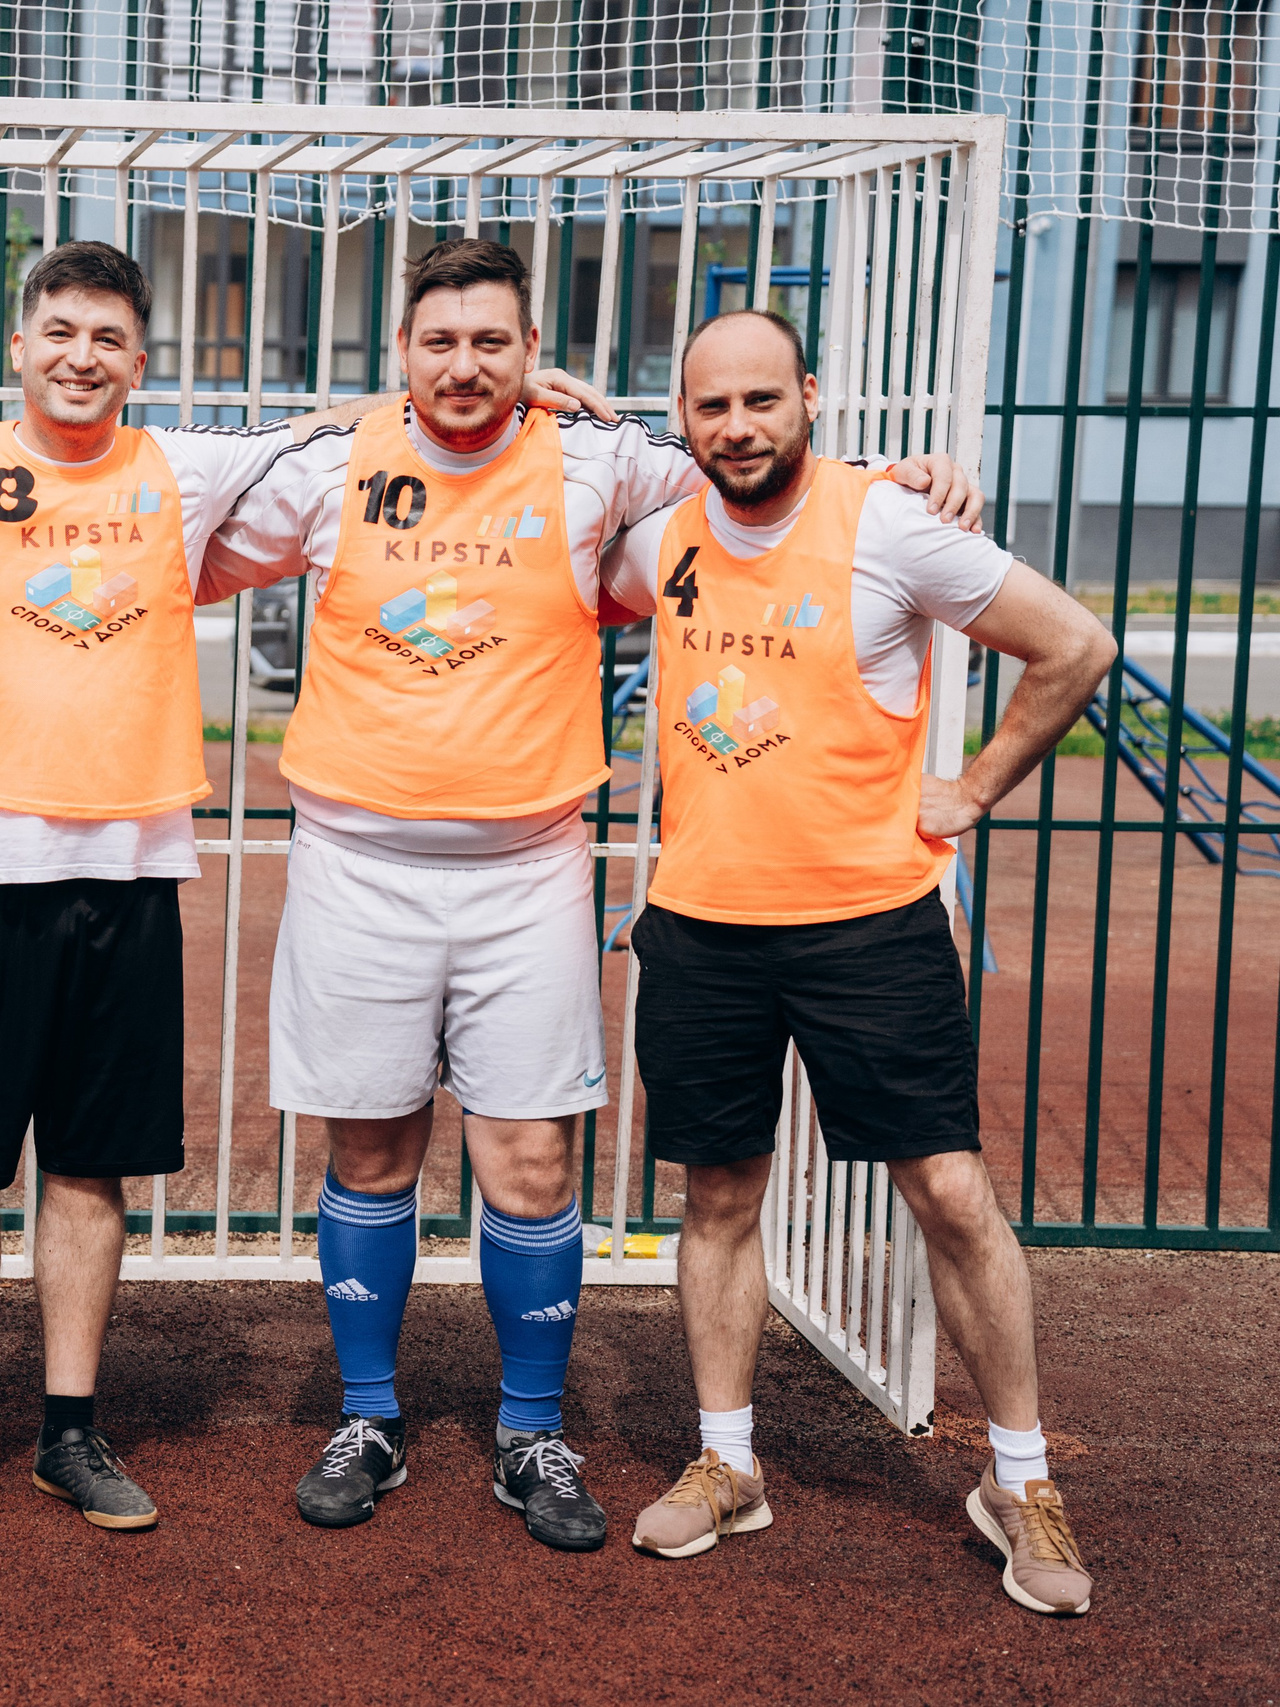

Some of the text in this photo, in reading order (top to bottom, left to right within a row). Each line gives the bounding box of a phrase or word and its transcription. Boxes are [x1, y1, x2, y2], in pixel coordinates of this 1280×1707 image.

[358, 470, 427, 530] 10
[20, 521, 144, 549] KIPSTA
[384, 540, 514, 568] KIPSTA
[662, 546, 701, 618] 4
[10, 605, 149, 650] СПОРТ У ДОМА
[682, 627, 797, 660] KIPSTA
[364, 627, 508, 676] СПОРТ У ДОМА
[673, 721, 792, 775] СПОРТ У ДОМА
[326, 1288, 379, 1301] adidas
